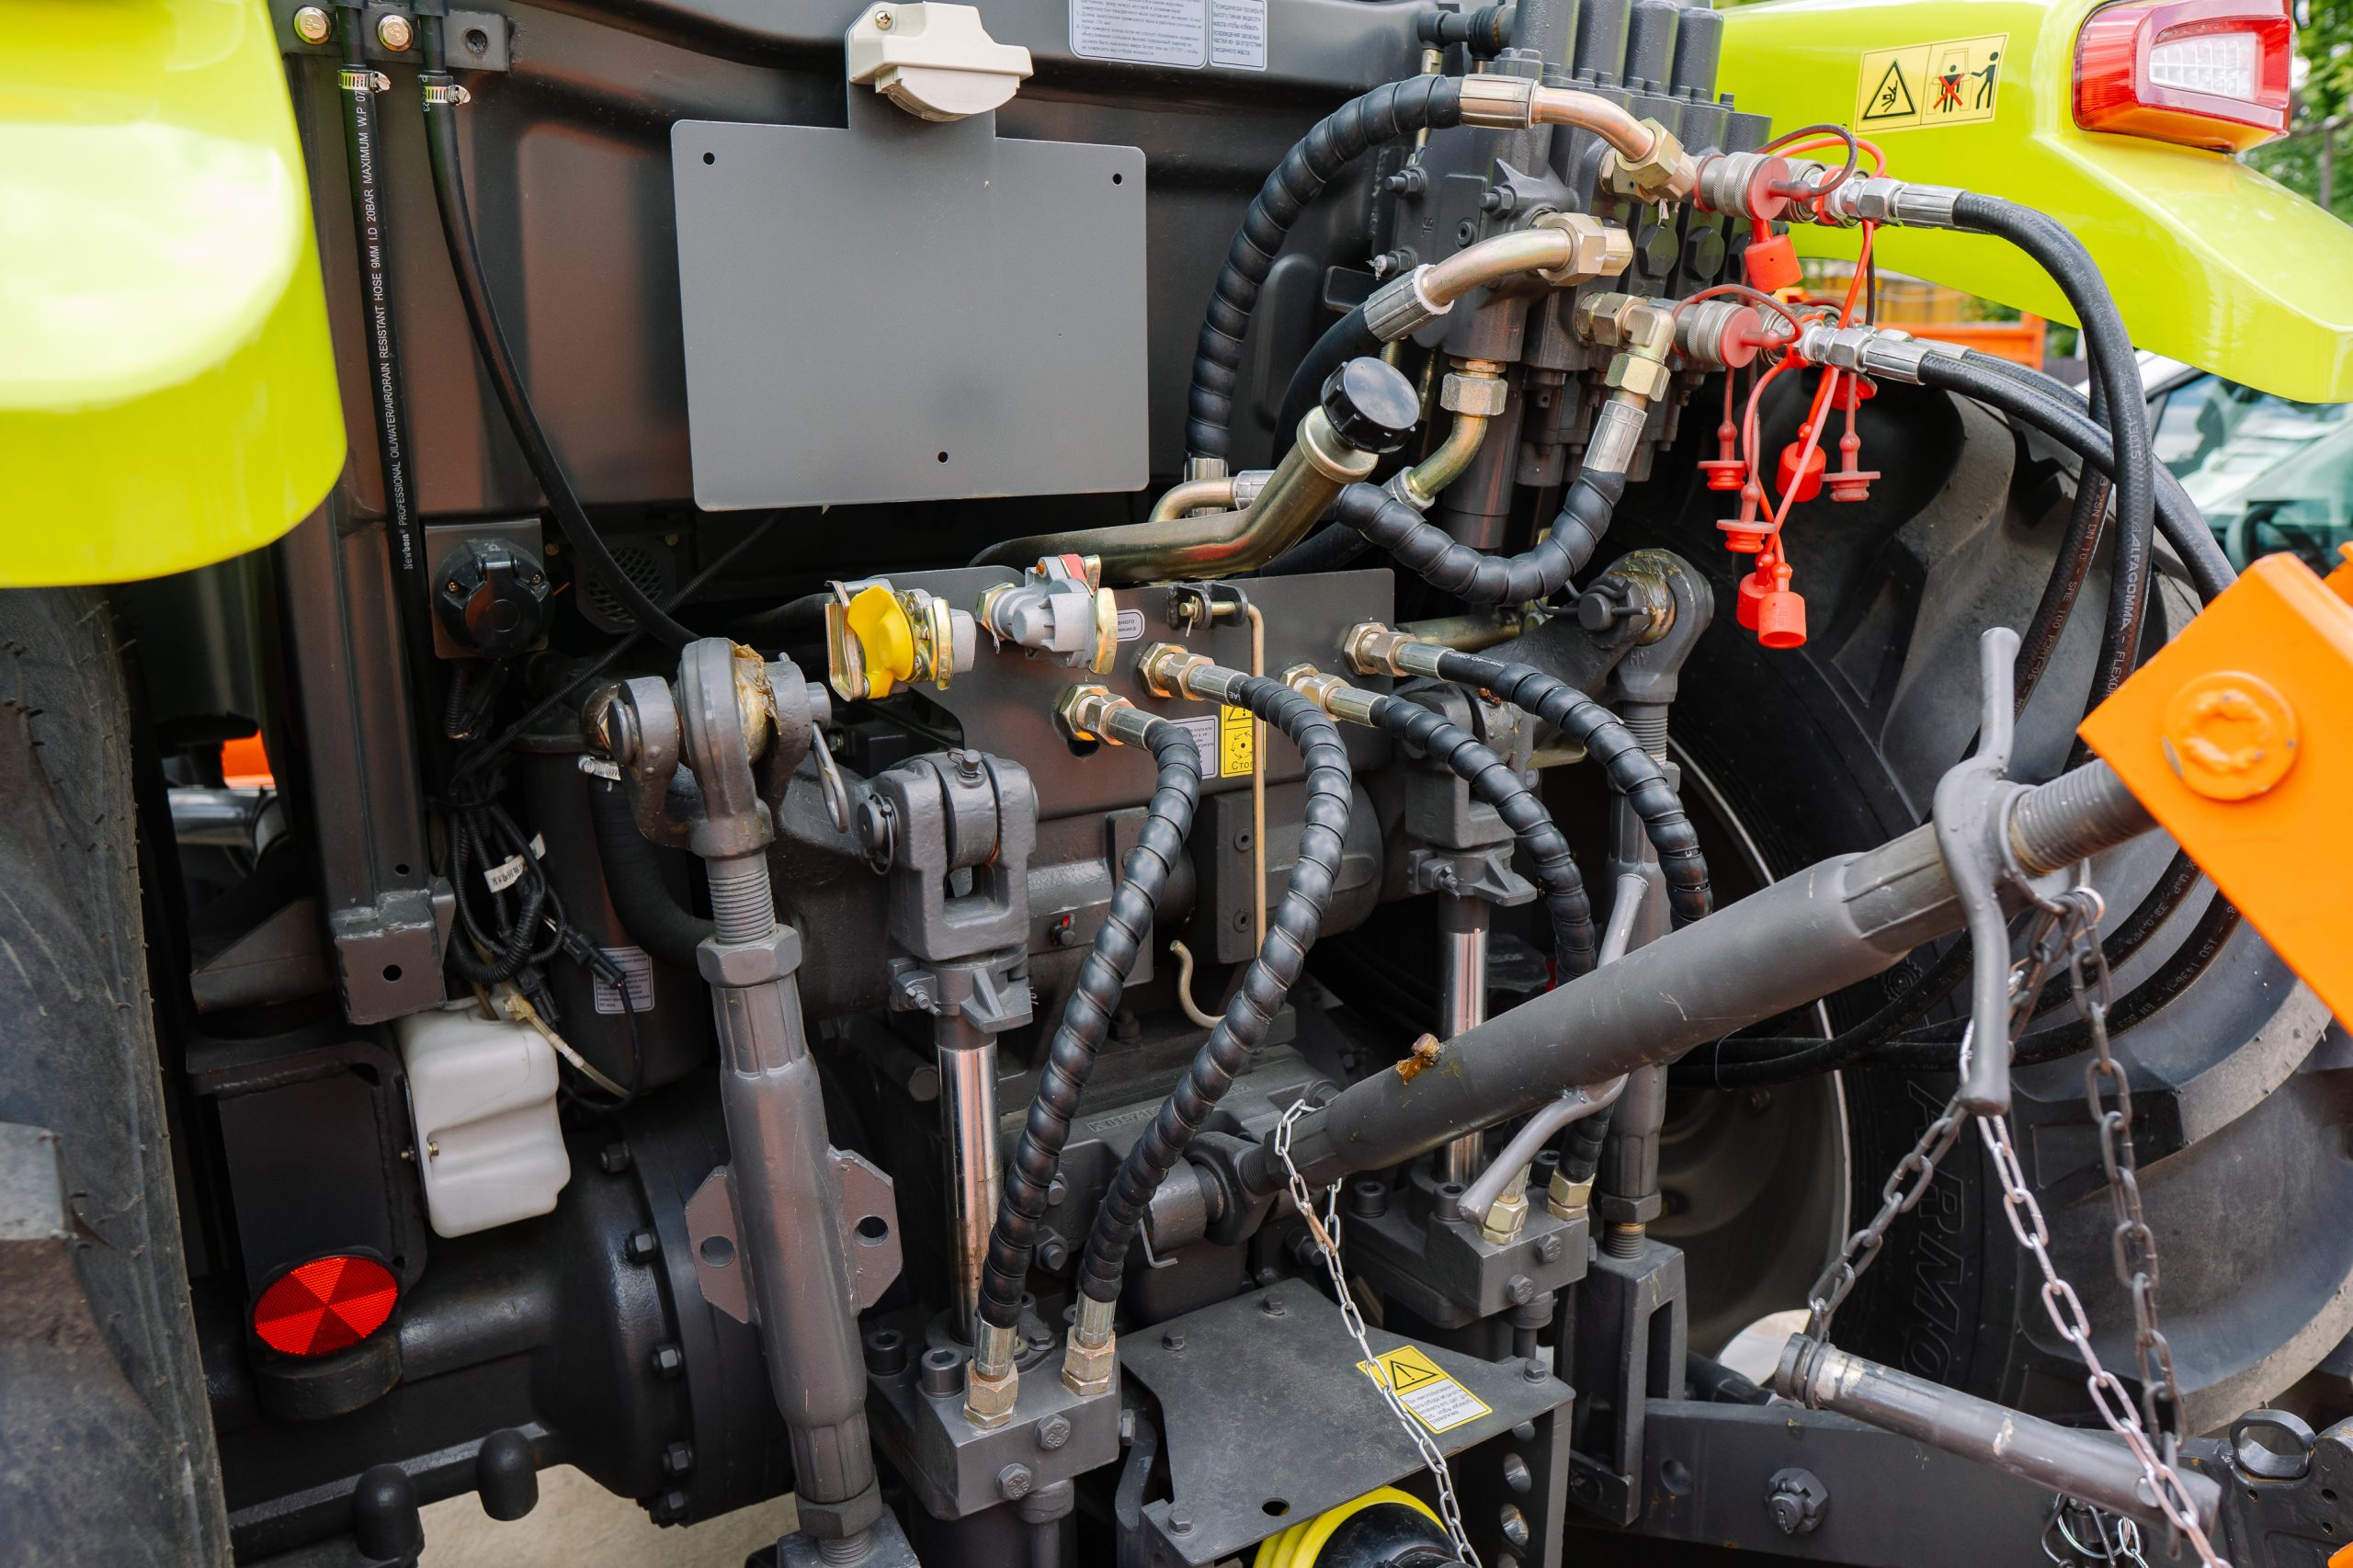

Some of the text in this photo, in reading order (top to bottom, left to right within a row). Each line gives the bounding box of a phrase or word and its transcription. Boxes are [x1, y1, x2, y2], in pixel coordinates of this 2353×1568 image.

[358, 132, 372, 184] MAXIMUM
[364, 189, 377, 222] 20BAR
[368, 227, 378, 240] I.D
[369, 245, 381, 268] 9MM
[371, 273, 383, 301] HOSE
[374, 305, 390, 358] RESISTANT
[380, 363, 399, 458] OIL/WATER/AIR/DRAIN
[391, 461, 407, 526] PROFESSIONAL
[2086, 524, 2097, 540] DN
[2063, 579, 2079, 603] SAE
[2120, 533, 2141, 632] ALFAGOMMA
[2052, 609, 2066, 629] 100
[2199, 939, 2218, 958] ISO
